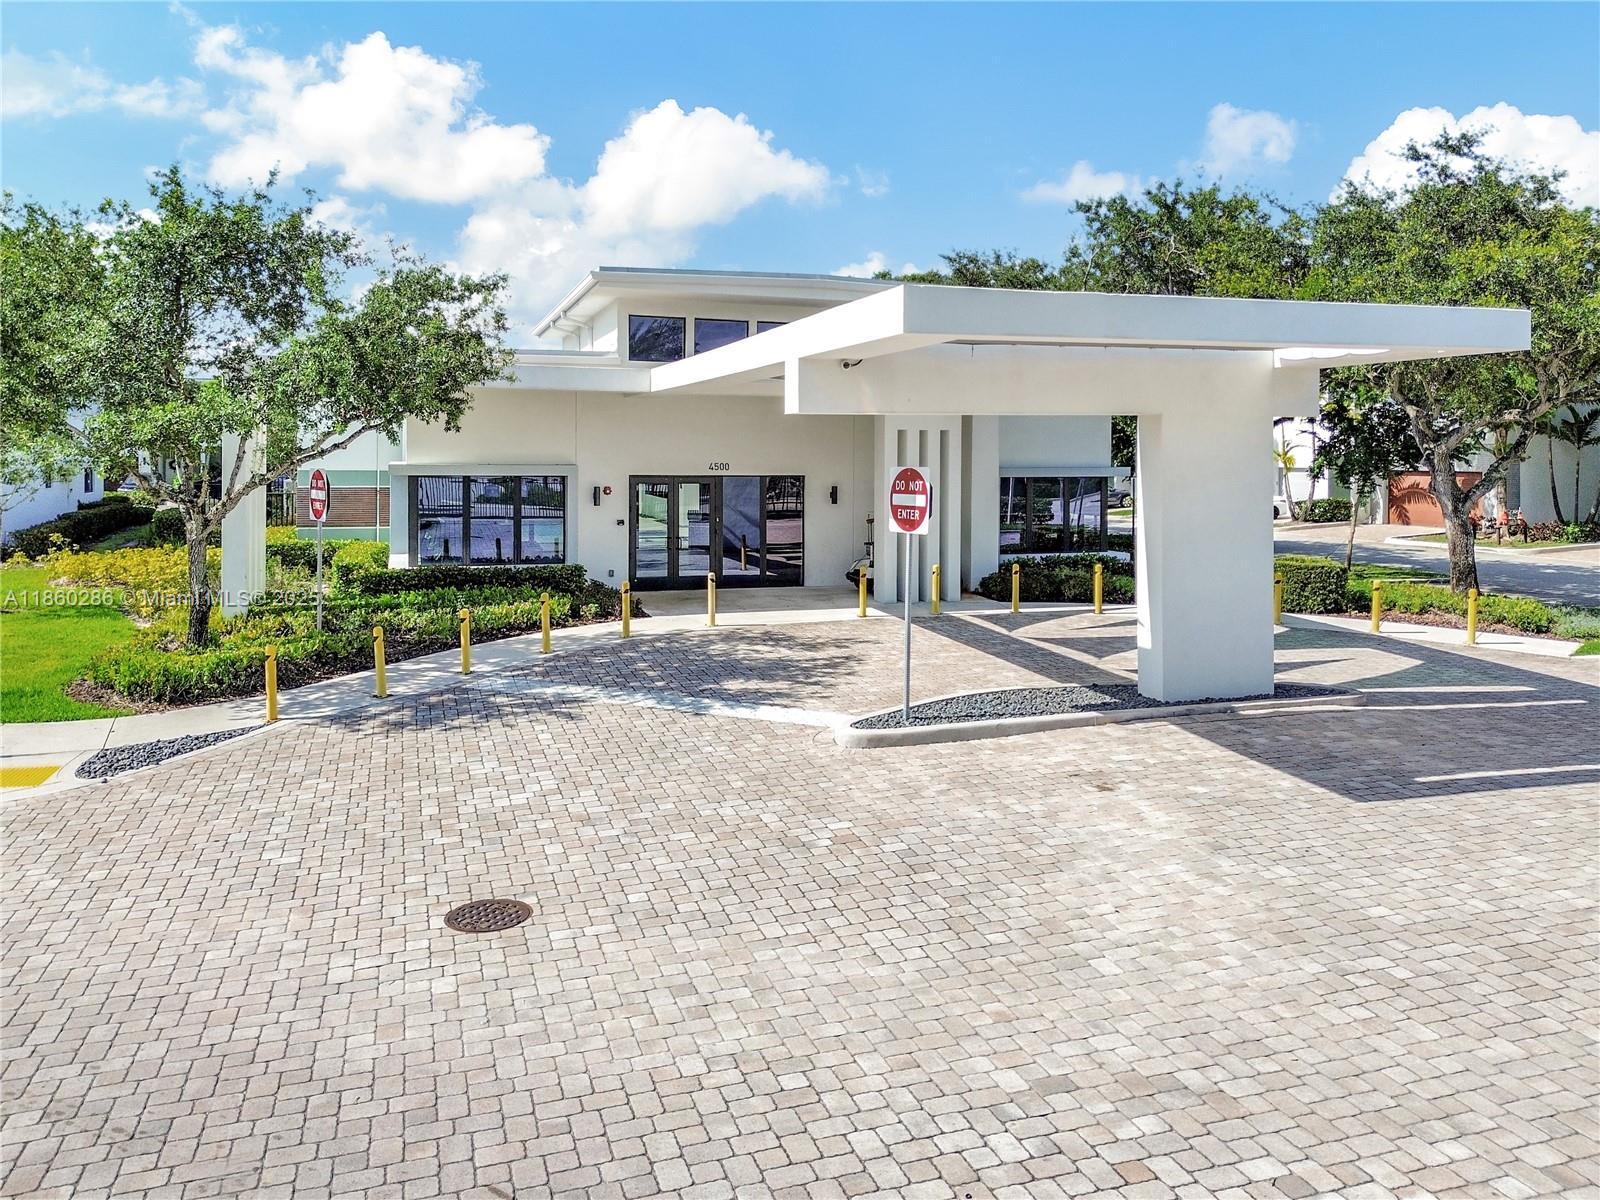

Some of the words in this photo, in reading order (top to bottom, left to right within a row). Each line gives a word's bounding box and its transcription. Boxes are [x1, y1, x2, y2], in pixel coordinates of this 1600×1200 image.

[708, 462, 730, 471] 4500
[895, 480, 906, 491] DO
[909, 480, 924, 491] NOT
[897, 508, 920, 520] ENTER
